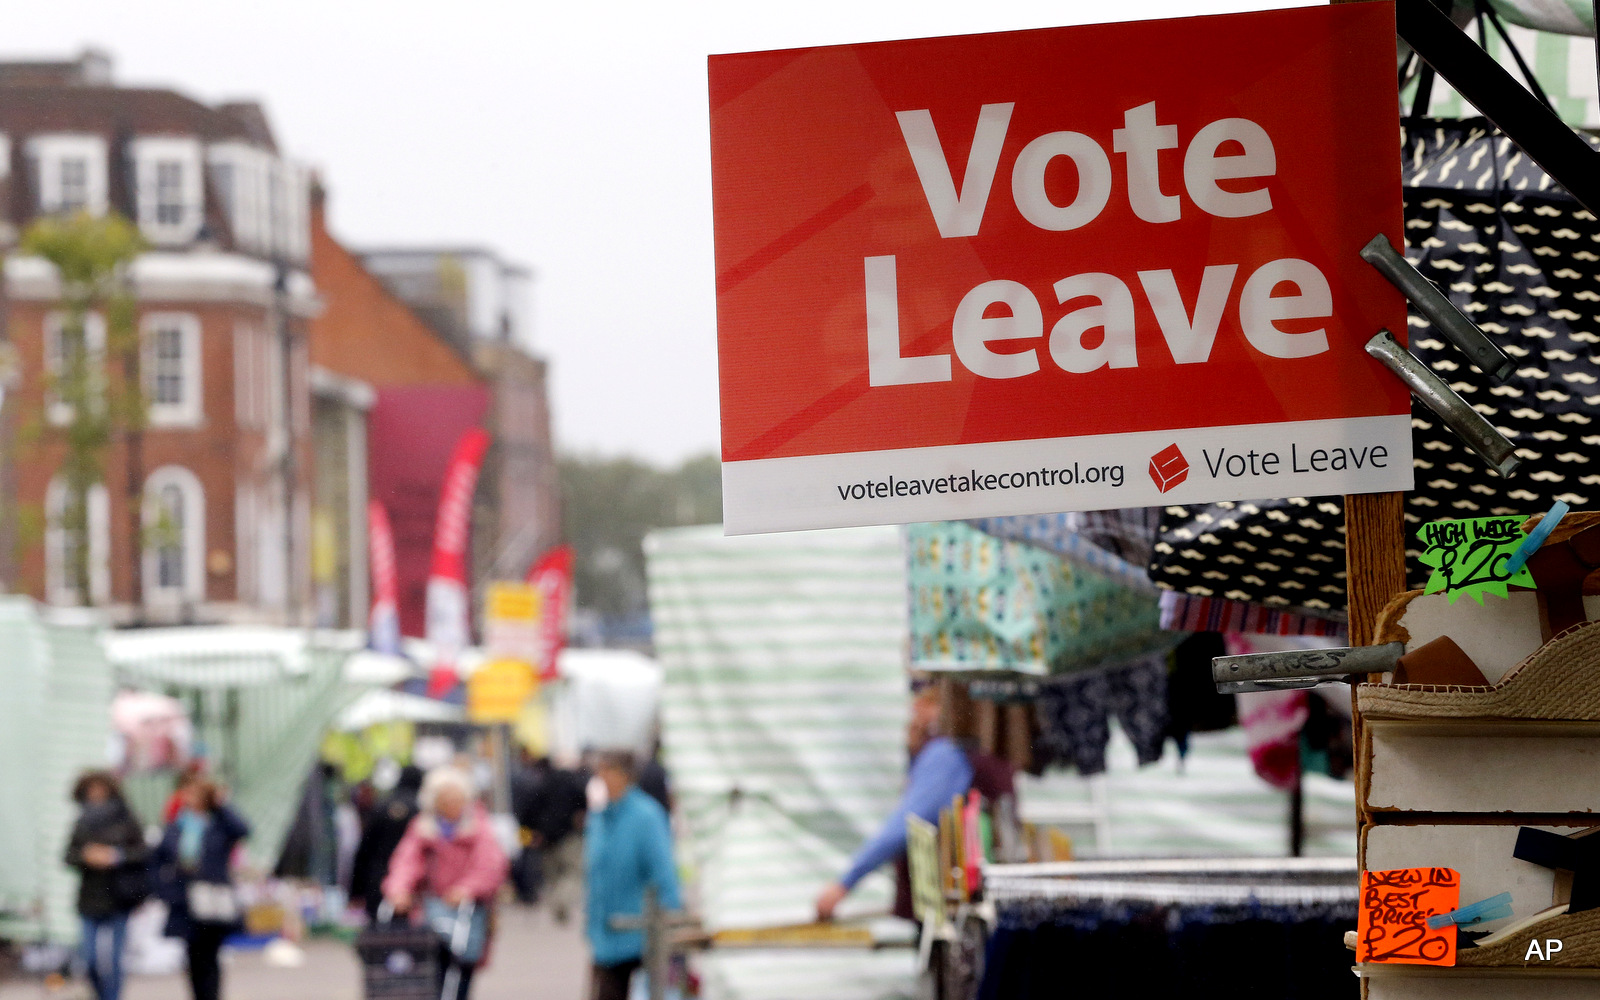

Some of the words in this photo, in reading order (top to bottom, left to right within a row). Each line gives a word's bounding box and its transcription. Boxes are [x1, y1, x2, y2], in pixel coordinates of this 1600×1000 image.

[895, 101, 1277, 239] Vote
[864, 255, 1334, 388] Leave
[1203, 447, 1280, 479] Vote
[1291, 443, 1389, 474] Leave
[838, 461, 1124, 501] voteleavetakecontrol.org
[1426, 521, 1468, 545] HIGH
[1367, 869, 1422, 886] NEW
[1428, 867, 1453, 884] IN
[1365, 888, 1430, 909] BEST
[1362, 925, 1449, 962] £20
